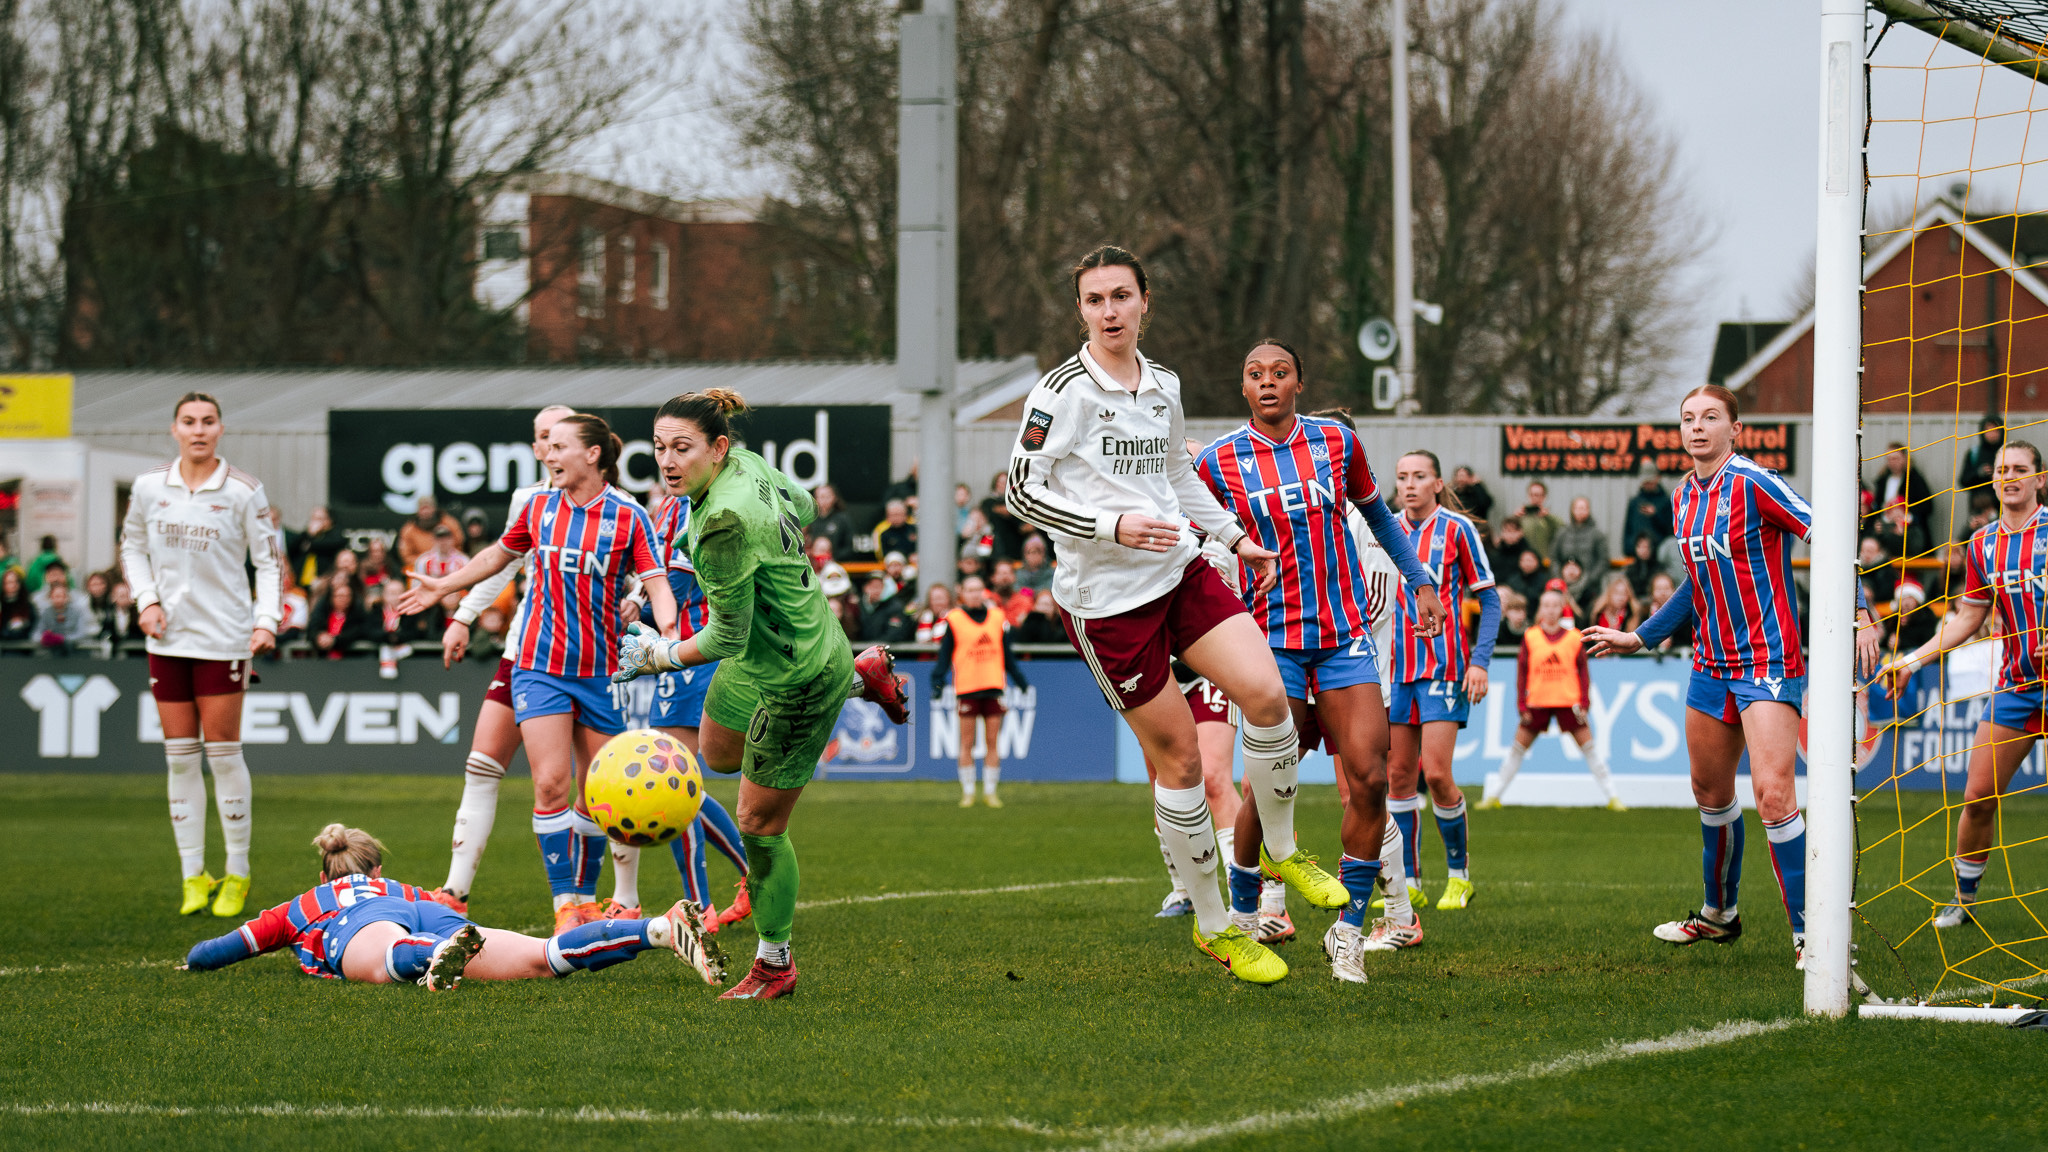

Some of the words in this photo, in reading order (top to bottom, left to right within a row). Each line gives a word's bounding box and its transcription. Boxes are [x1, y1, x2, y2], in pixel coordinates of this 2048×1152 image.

[1102, 435, 1168, 456] Emirates
[1636, 424, 1682, 450] Pes
[1113, 459, 1134, 475] FLY
[1136, 457, 1165, 475] BETTER
[1247, 475, 1336, 518] TEN
[157, 519, 221, 540] Emirates
[539, 544, 612, 578] TEN
[1677, 532, 1733, 564] TEN
[1986, 567, 2048, 595] TEN
[929, 709, 1037, 760] NW
